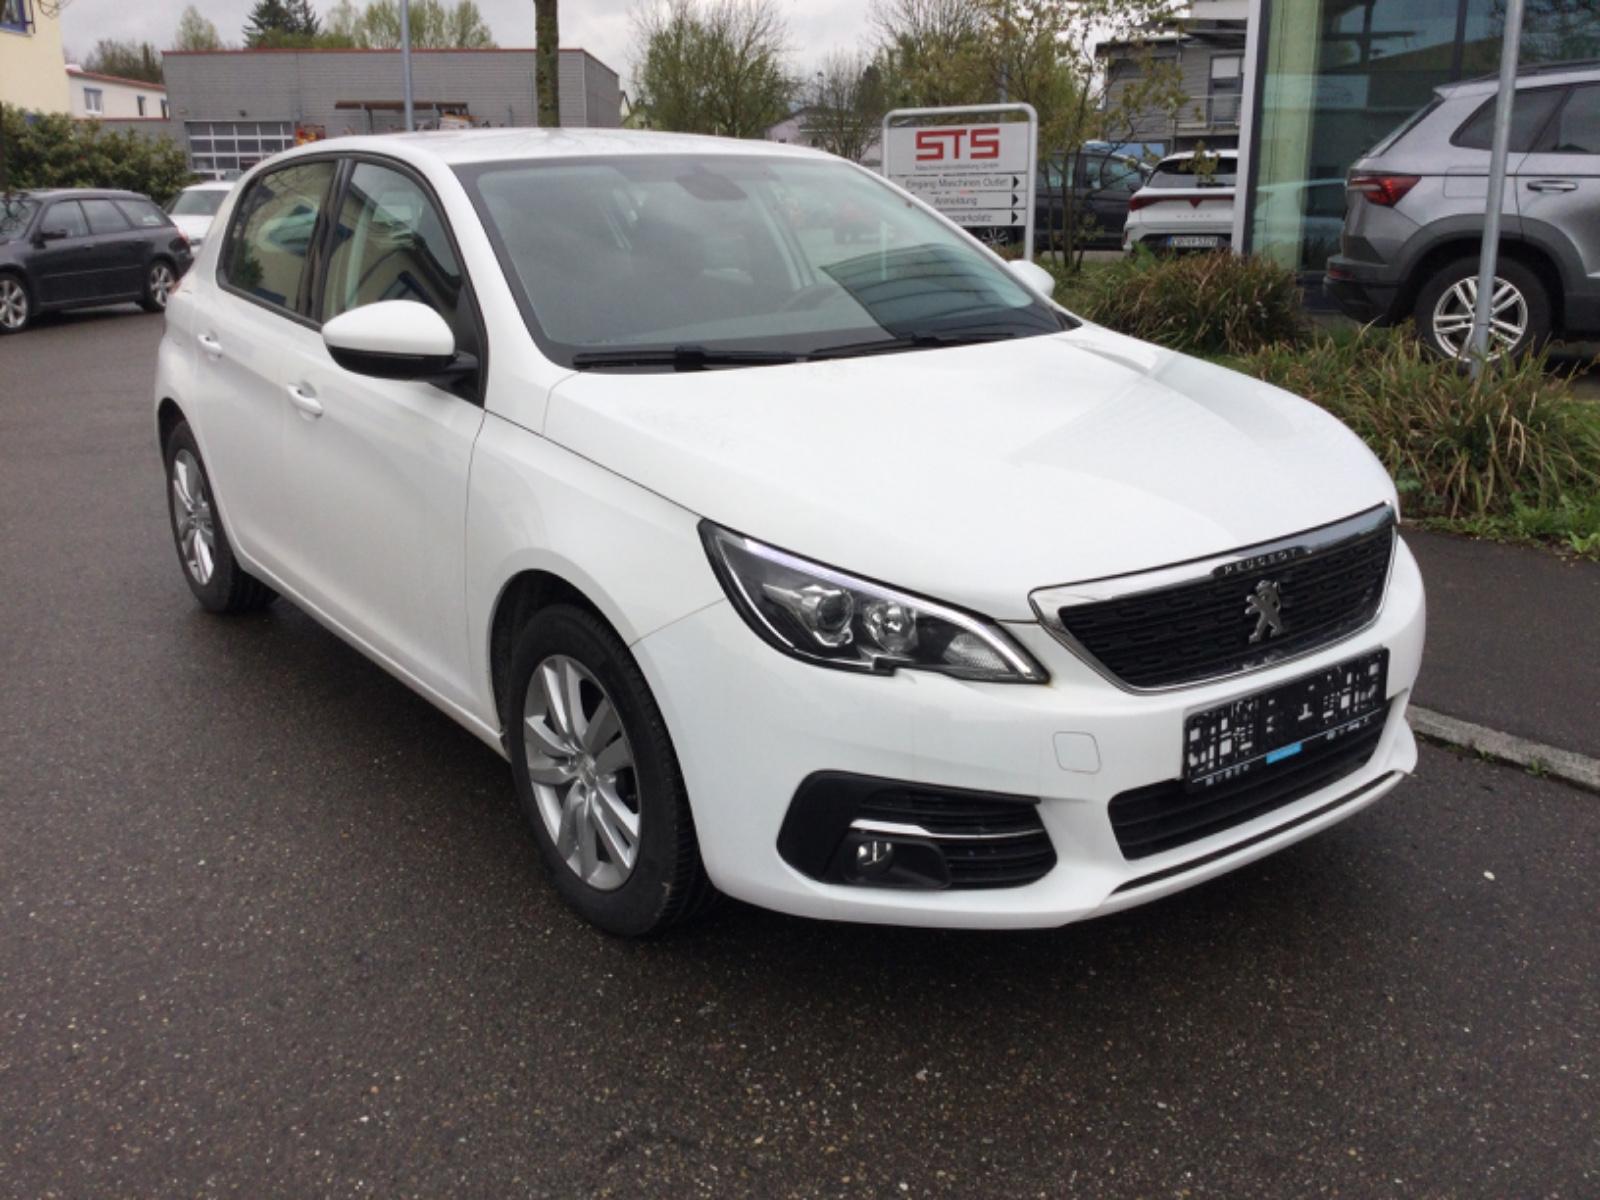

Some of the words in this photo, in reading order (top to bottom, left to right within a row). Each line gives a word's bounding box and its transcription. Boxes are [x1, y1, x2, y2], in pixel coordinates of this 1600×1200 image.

[915, 127, 1000, 161] STS
[905, 179, 936, 190] Eingang
[939, 178, 981, 188] Maschinen
[934, 196, 978, 206] Anmeldung
[1224, 549, 1297, 576] PEUGEOT
